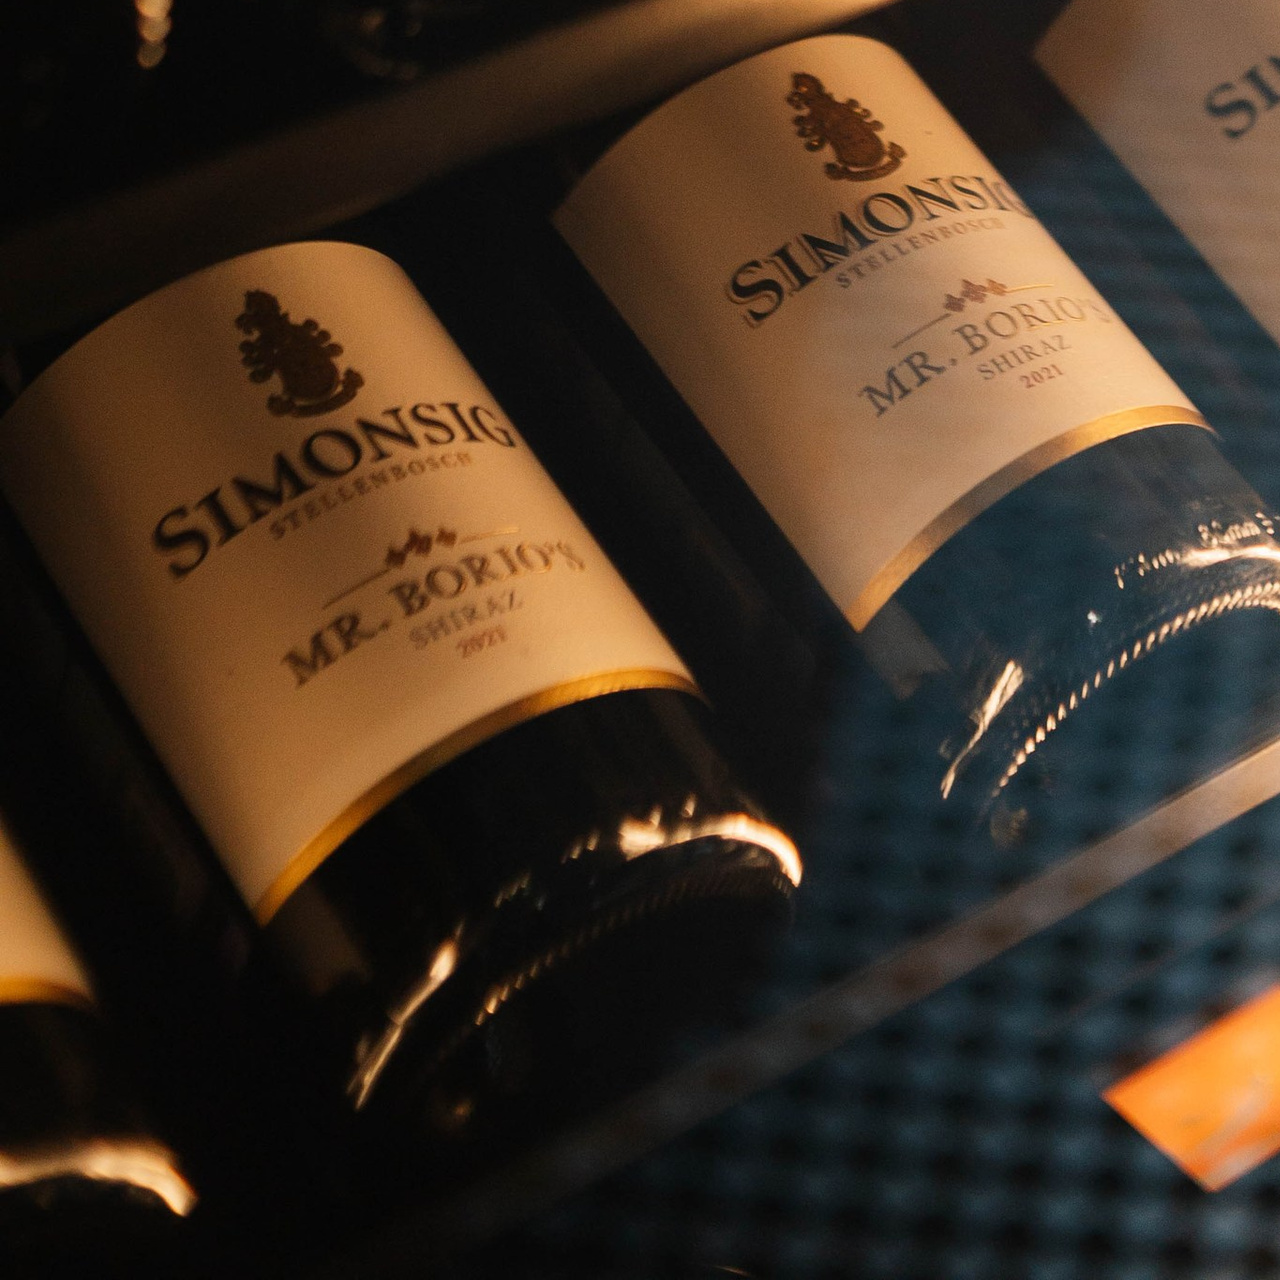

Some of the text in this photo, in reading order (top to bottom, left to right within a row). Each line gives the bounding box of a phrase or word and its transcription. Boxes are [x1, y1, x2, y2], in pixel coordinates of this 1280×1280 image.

[857, 350, 957, 419] MR.
[976, 334, 1074, 382] SHIRAZ
[1018, 364, 1064, 391] 2021
[151, 400, 519, 582] SIMONSIG
[269, 449, 473, 541] STELLENBOSCH
[281, 540, 588, 690] MR. BORIO'S
[408, 587, 525, 652] SHIRAZ
